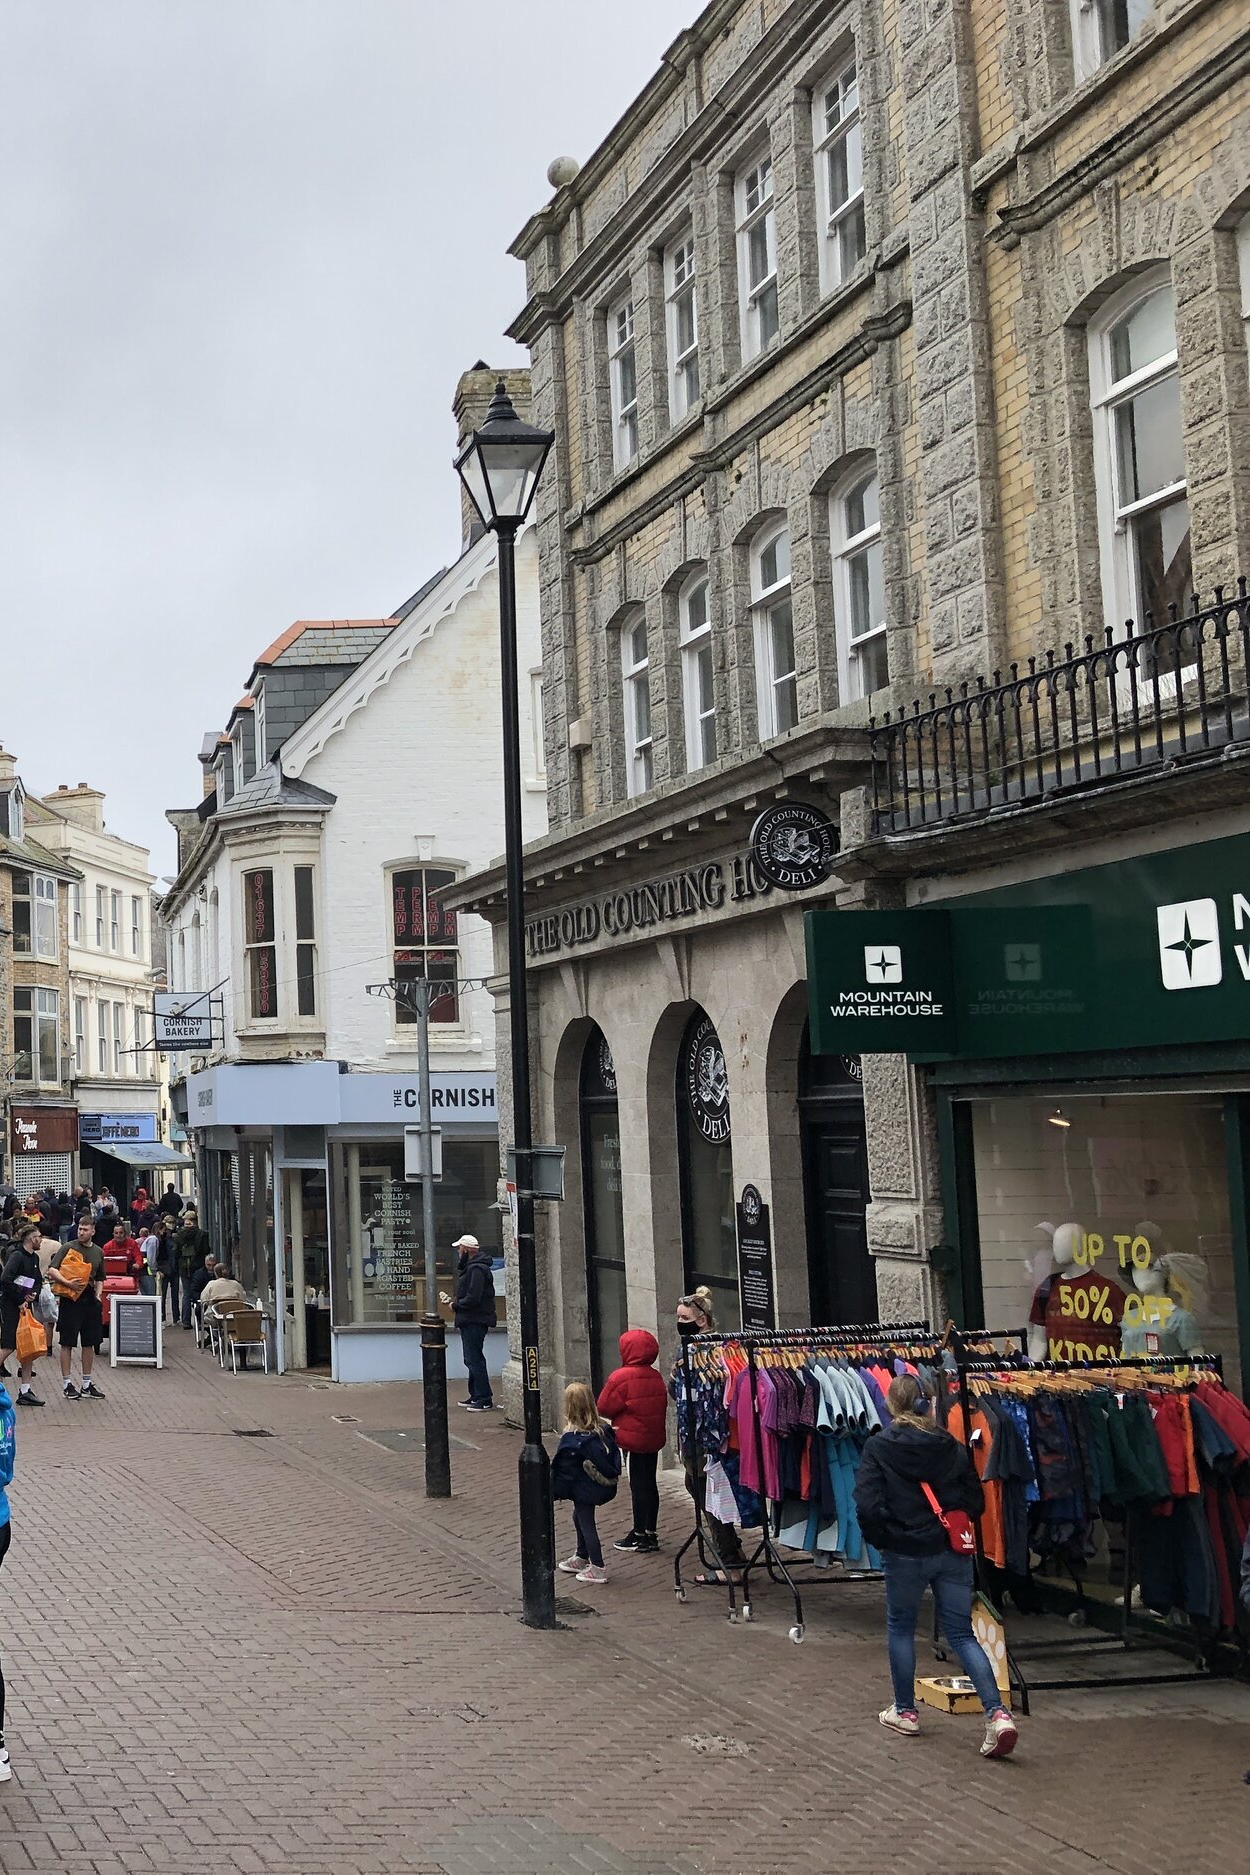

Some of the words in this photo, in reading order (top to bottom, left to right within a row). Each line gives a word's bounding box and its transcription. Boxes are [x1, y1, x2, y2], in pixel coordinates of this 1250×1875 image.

[772, 811, 823, 829] COUNTING
[760, 823, 773, 843] OLD
[760, 844, 771, 866] THE
[778, 869, 817, 885] DELI
[254, 873, 265, 938] 01637
[395, 887, 406, 936] TEMP
[411, 887, 423, 937] PERM
[525, 914, 559, 957] THE
[560, 902, 600, 946] OLD
[602, 863, 724, 935] COUNTING
[839, 991, 932, 1003] MOUNTAIN
[830, 1004, 943, 1017] WAREHOUSE
[163, 1018, 203, 1027] CORNISH
[165, 1027, 200, 1037] BAKERY
[393, 1089, 402, 1108] THE
[404, 1088, 495, 1108] CRNISH
[702, 1113, 730, 1139] DELI
[382, 1201, 402, 1209] BEST
[380, 1217, 406, 1225] PASTY
[377, 1249, 411, 1257] FRENCH
[1071, 1232, 1104, 1266] UP
[1113, 1235, 1151, 1270] TO
[386, 1266, 411, 1274] HAND
[1058, 1285, 1113, 1325] 50%
[1124, 1292, 1173, 1330] OFF
[528, 1348, 537, 1390] A254
